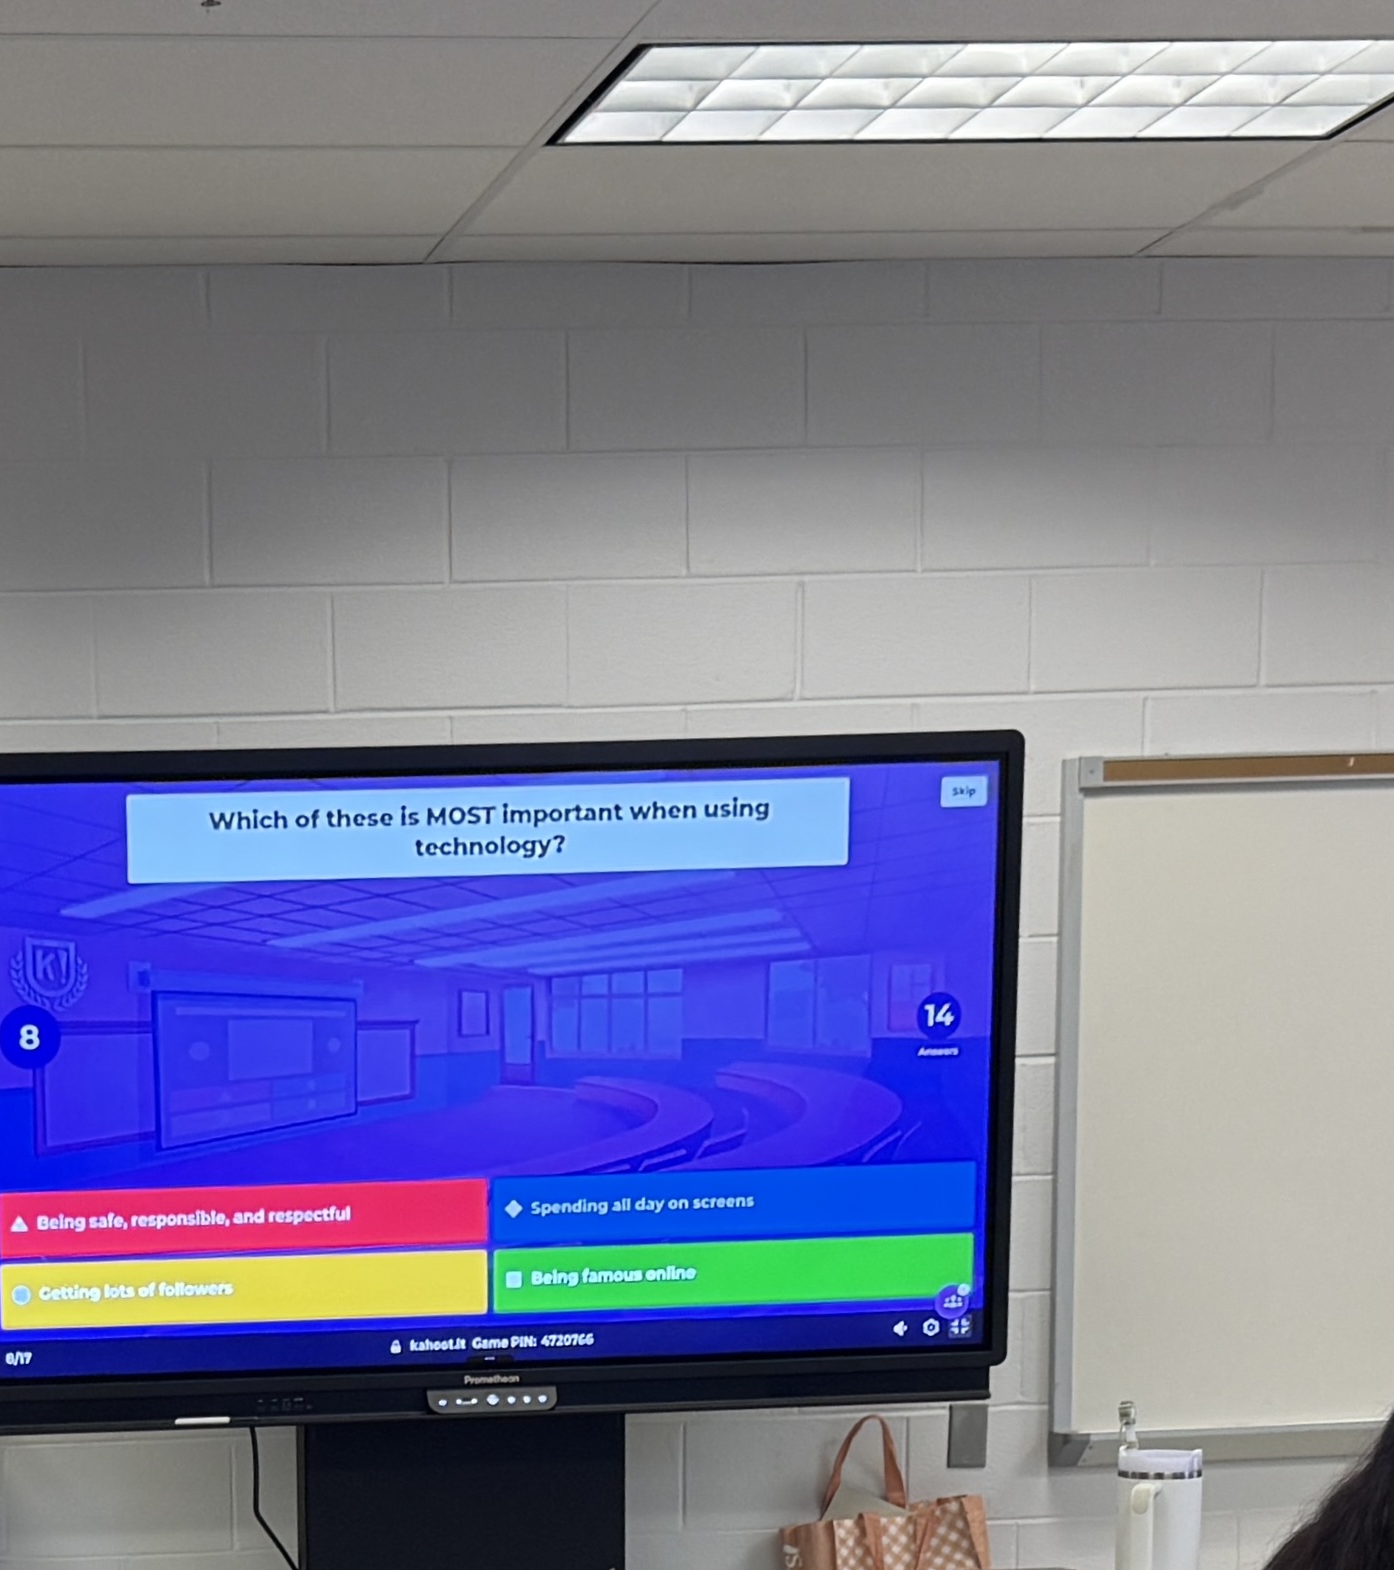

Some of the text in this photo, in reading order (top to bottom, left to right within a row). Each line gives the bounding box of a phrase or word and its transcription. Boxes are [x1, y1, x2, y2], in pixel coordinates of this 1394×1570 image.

[952, 786, 976, 797] Skip
[209, 797, 770, 830] Which of these is MOST important when using
[415, 834, 565, 858] technology?
[924, 1003, 954, 1027] 14
[19, 1024, 40, 1050] 8
[531, 1195, 754, 1216] Spending all day on screens
[37, 1206, 350, 1232] Being safe, responsible, and respectful
[531, 1266, 696, 1288] Being famous online
[39, 1282, 233, 1303] Getting lots of followers
[410, 1338, 466, 1351] kahoot.it
[472, 1336, 508, 1349] Game
[510, 1336, 537, 1348] PIN:
[464, 1375, 519, 1385] Promethean
